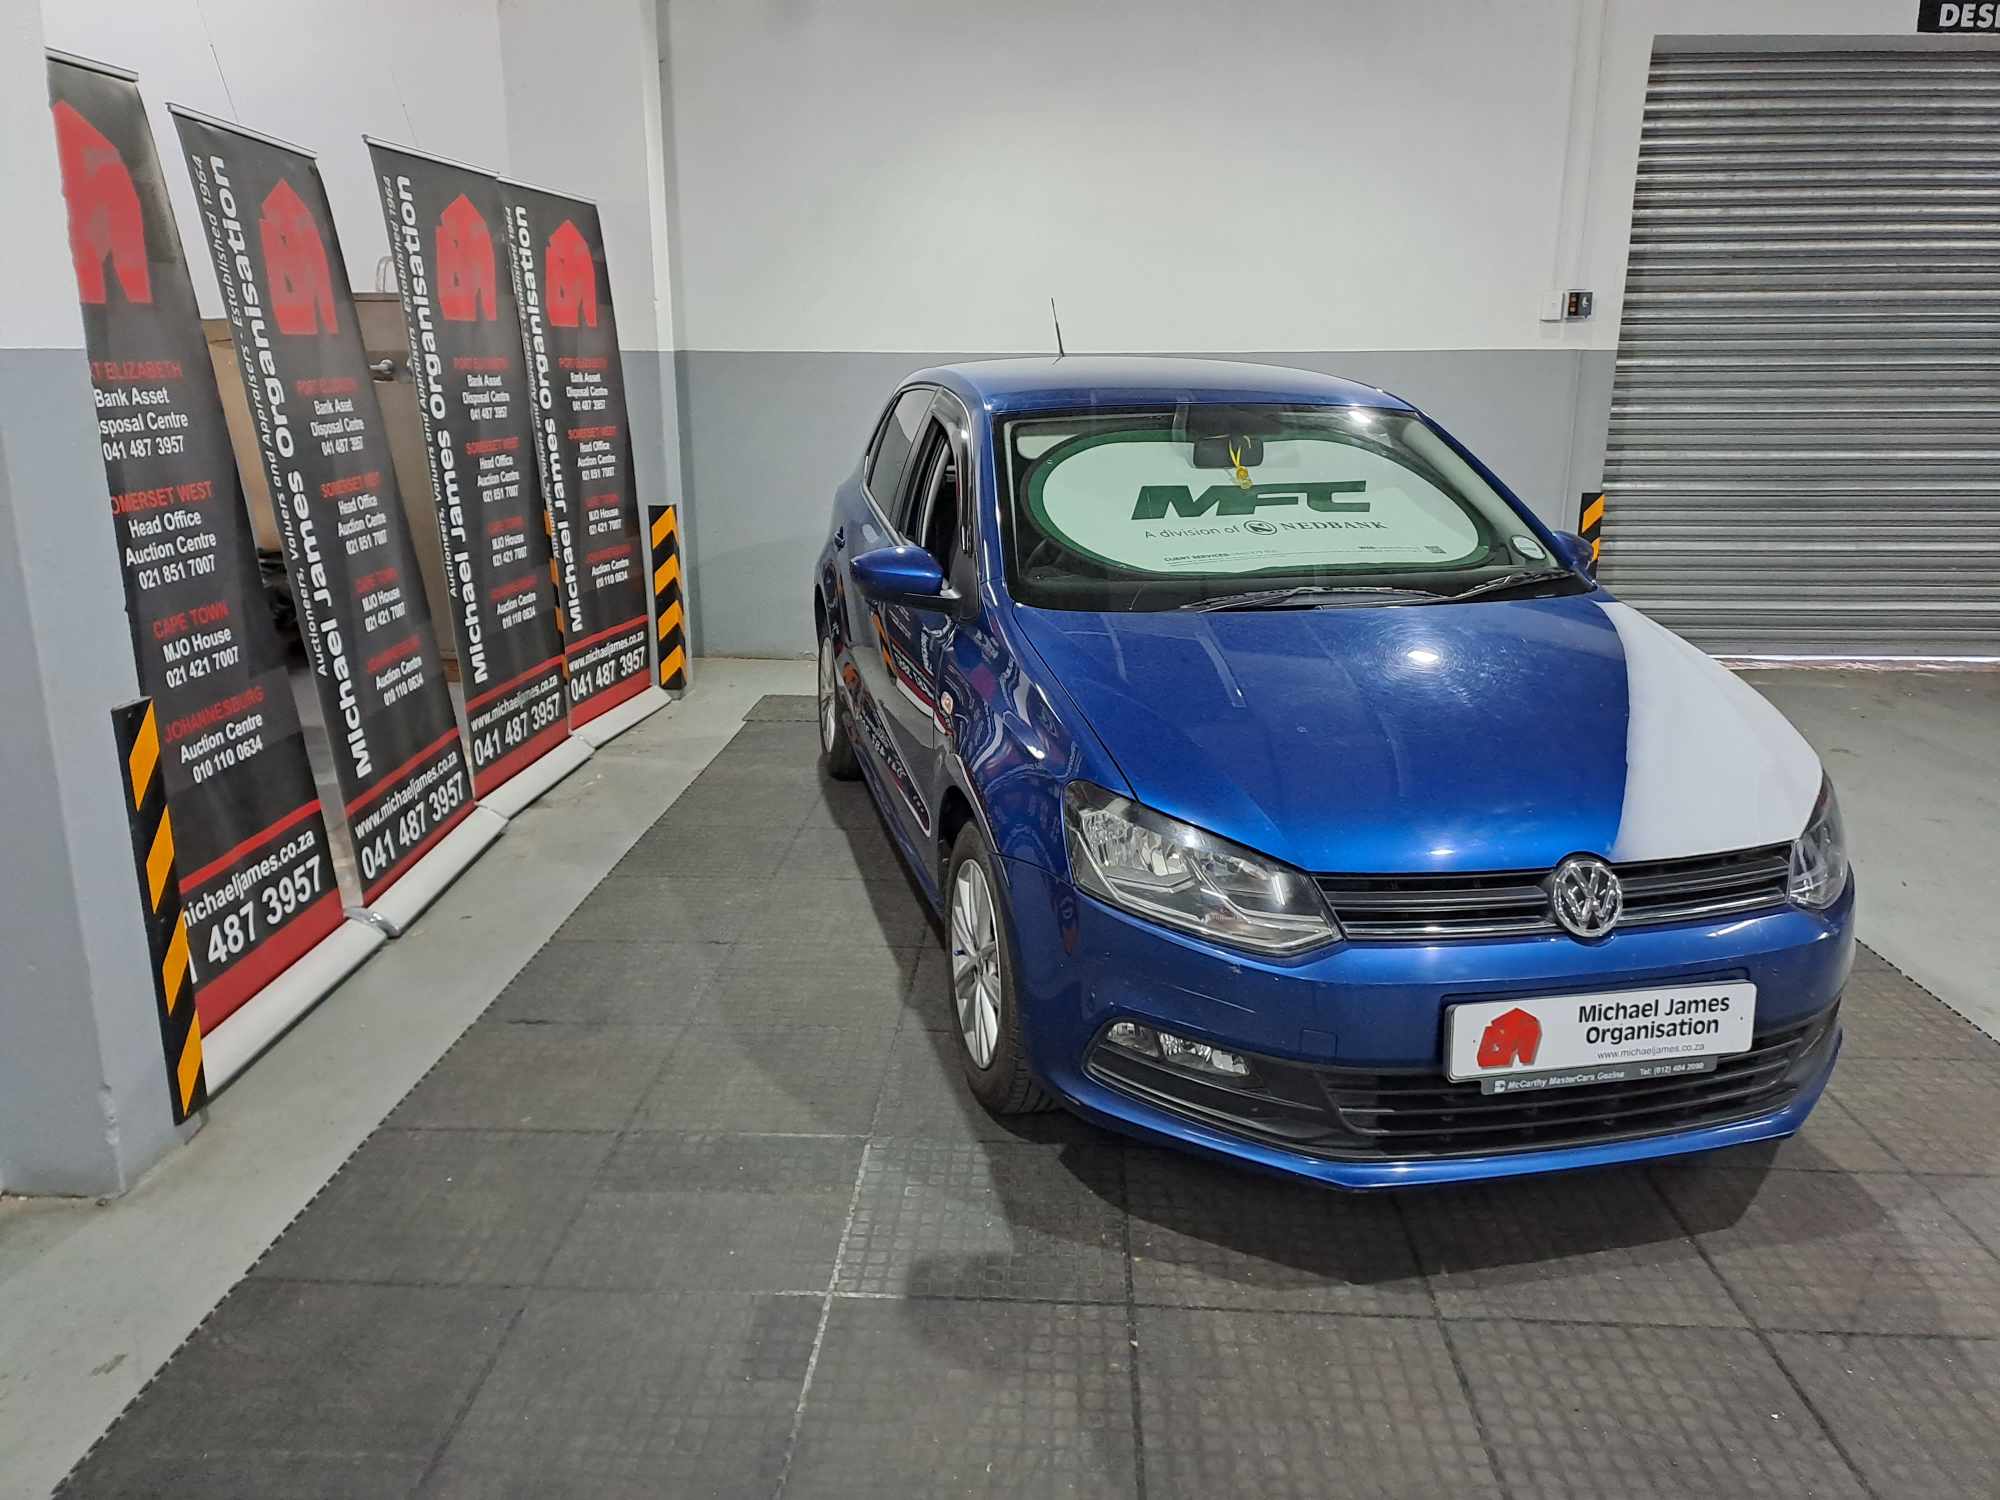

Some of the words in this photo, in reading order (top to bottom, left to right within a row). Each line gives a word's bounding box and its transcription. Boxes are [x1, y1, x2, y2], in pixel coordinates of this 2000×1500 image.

[192, 154, 212, 206] 1964
[206, 211, 243, 327] Established
[209, 155, 294, 458] Organisation
[396, 175, 446, 420] Organisation
[515, 206, 551, 410] Organisation
[94, 388, 129, 407] Bank
[131, 386, 170, 405] Asset
[241, 344, 272, 446] Appraisers
[99, 413, 144, 437] sposal
[146, 411, 189, 430] Centre
[102, 442, 127, 461] 041
[130, 439, 151, 458] 487
[156, 435, 184, 455] 3957
[265, 450, 282, 488] and
[437, 430, 467, 543] James
[544, 418, 567, 513] James
[111, 487, 174, 516] OMERSET
[178, 480, 214, 503] WEST
[128, 515, 162, 538] Head
[164, 510, 201, 531] Office
[1130, 480, 1371, 520] MFC
[126, 541, 175, 567] Auction
[176, 532, 217, 556] Centre
[277, 492, 299, 560] Valuers
[288, 470, 332, 607] James
[1145, 531, 1156, 539] A
[1160, 527, 1221, 538] division
[1222, 524, 1241, 534] of
[1281, 520, 1388, 530] NEDBANK
[138, 570, 161, 590] 021
[162, 563, 186, 583] 851
[188, 554, 216, 577] 7007
[557, 520, 584, 633] Michael
[153, 612, 188, 639] CAPE
[189, 600, 229, 625] TOWN
[296, 568, 328, 677] Auctioneers,
[454, 552, 488, 684] Michael
[162, 638, 190, 663] MJO
[192, 628, 232, 652] House
[166, 666, 187, 688] 021
[189, 657, 211, 679] 421
[213, 646, 240, 671] 7007
[320, 618, 372, 778] Michael
[570, 672, 594, 701] 041
[595, 658, 616, 688] 487
[620, 646, 645, 677] 3957
[181, 731, 225, 764] Auction
[225, 713, 263, 740] Centre
[473, 728, 501, 766] 041
[504, 711, 528, 748] 487
[531, 691, 561, 731] 3957
[192, 759, 213, 784] 010
[214, 749, 235, 771] 110
[236, 734, 264, 761] 0634
[354, 750, 458, 840] www.michaeljames.co.za
[361, 827, 397, 880] 041
[399, 803, 425, 847] 487
[428, 771, 464, 822] 3957
[182, 829, 316, 929] michaeljames.co.za
[207, 900, 256, 964] 487
[261, 854, 321, 926] 3957
[1578, 998, 1659, 1023] Michael
[1664, 995, 1730, 1016] James
[1585, 1016, 1719, 1045] Organisation
[1597, 1043, 1705, 1059] www.michaeljames.co.za
[1507, 1078, 1547, 1089] McCarthy
